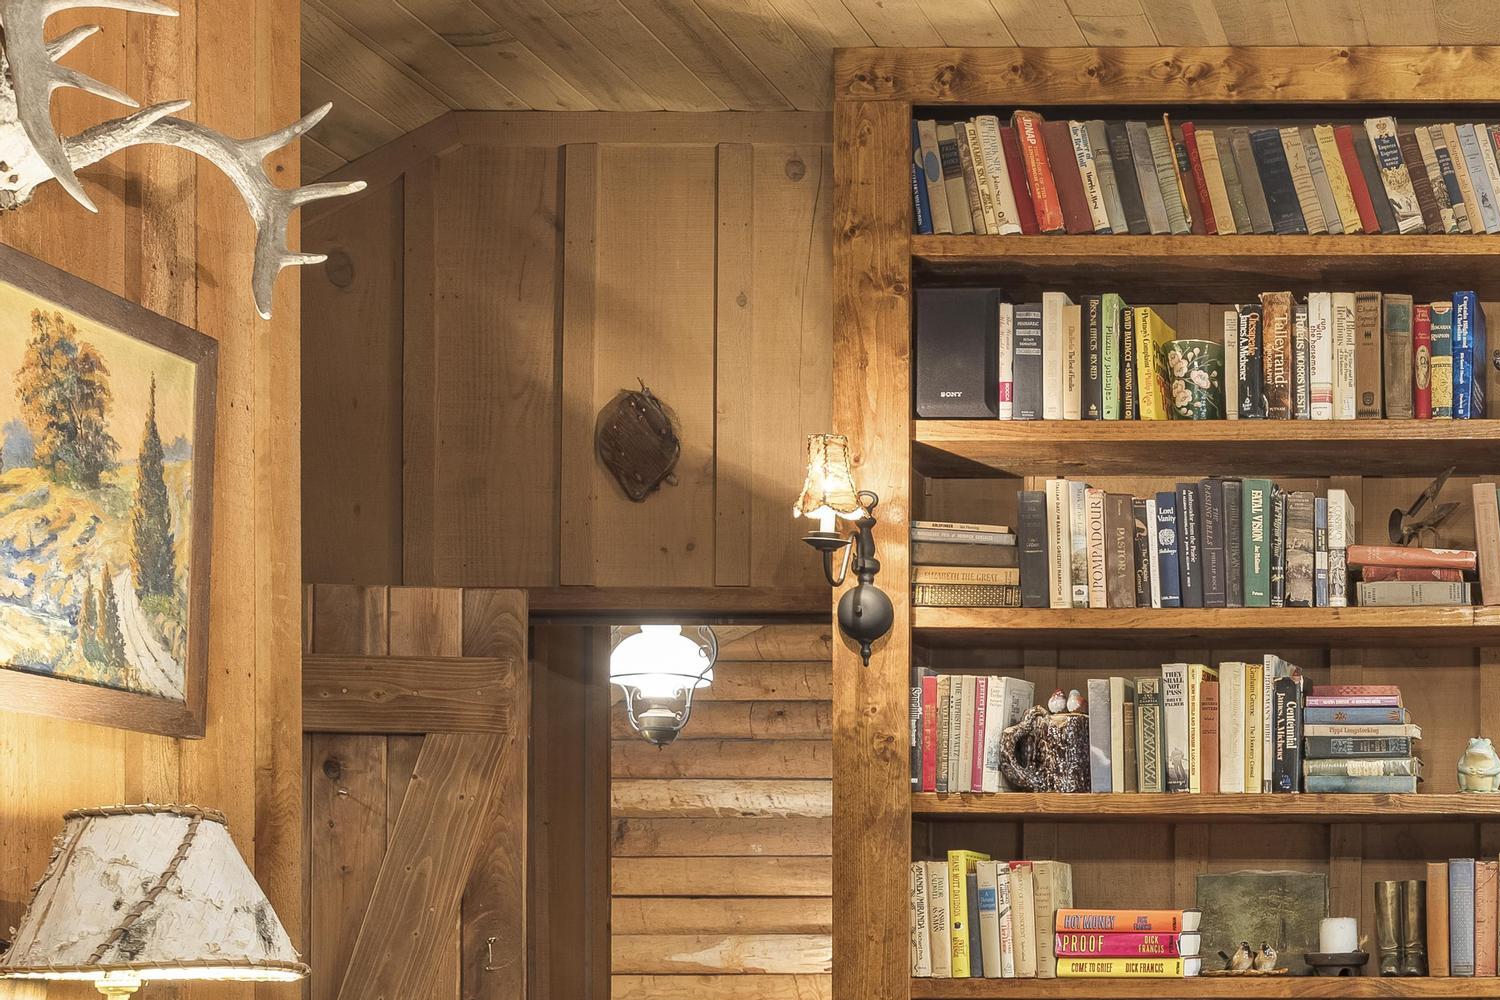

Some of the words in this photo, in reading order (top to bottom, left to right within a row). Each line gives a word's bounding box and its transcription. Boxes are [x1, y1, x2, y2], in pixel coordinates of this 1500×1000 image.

[1071, 126, 1079, 138] the
[1074, 139, 1082, 151] Red
[1080, 125, 1090, 151] Summer
[968, 129, 982, 166] CINNAMON
[976, 168, 987, 185] SKIN
[1077, 151, 1086, 168] Wolf
[1124, 310, 1132, 329] DAVID
[1238, 314, 1248, 337] James
[1295, 312, 1306, 349] Proteus
[1336, 306, 1346, 346] Relations
[1105, 326, 1113, 354] Plazas
[1248, 312, 1260, 356] Chesapeake
[1345, 320, 1355, 346] Blood
[1124, 331, 1132, 362] BALDACCI
[1273, 314, 1287, 389] Talleyrand:
[1239, 346, 1248, 381] Michener
[1296, 351, 1305, 385] MORRIS
[1104, 364, 1114, 401] paisajes
[1297, 385, 1306, 408] WEST
[1204, 484, 1212, 518] PASSING
[1251, 490, 1263, 513] FATAL
[1157, 515, 1176, 524] Vanity
[1252, 516, 1264, 542] VISION
[1091, 501, 1103, 588] POMPADOUR
[1116, 527, 1126, 578] PASTORA
[962, 572, 973, 580] THE
[976, 574, 998, 582] GREAT
[1276, 692, 1285, 716] James
[1285, 701, 1297, 749] Centennial
[953, 733, 961, 757] WALTZ
[1064, 915, 1081, 929] HOT
[1082, 915, 1115, 930] MONEY
[1062, 935, 1105, 953] PROOF
[1139, 946, 1164, 954] FRANCIS
[1071, 963, 1088, 972] COME
[1089, 963, 1096, 972] TO
[1097, 963, 1112, 972] GRIEF
[1125, 963, 1138, 973] DICK
[1139, 963, 1164, 973] FRANCIS
